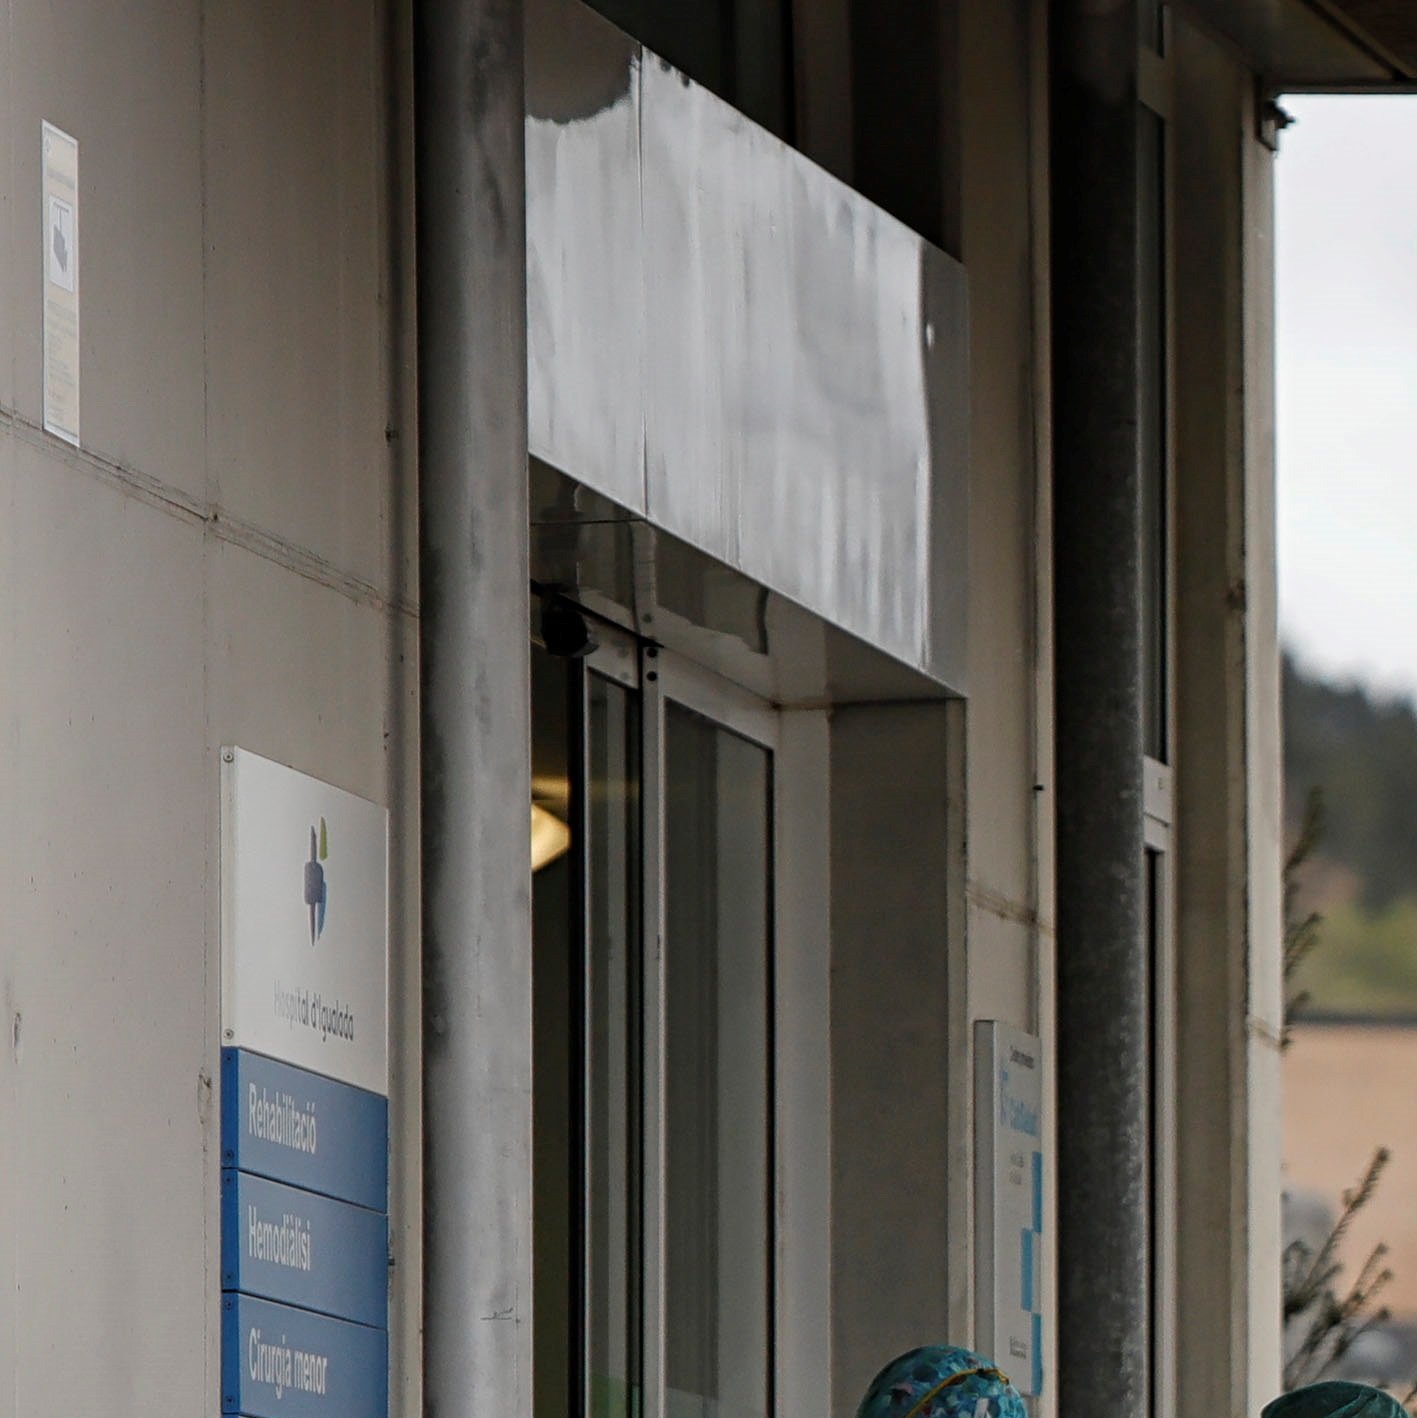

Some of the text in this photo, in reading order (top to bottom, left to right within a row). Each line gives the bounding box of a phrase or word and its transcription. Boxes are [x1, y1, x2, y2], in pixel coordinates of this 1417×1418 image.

[249, 1082, 317, 1154] Rehabilitació
[249, 1205, 311, 1271] Hemodiàlisi
[249, 1328, 328, 1399] Cirurgia menor
